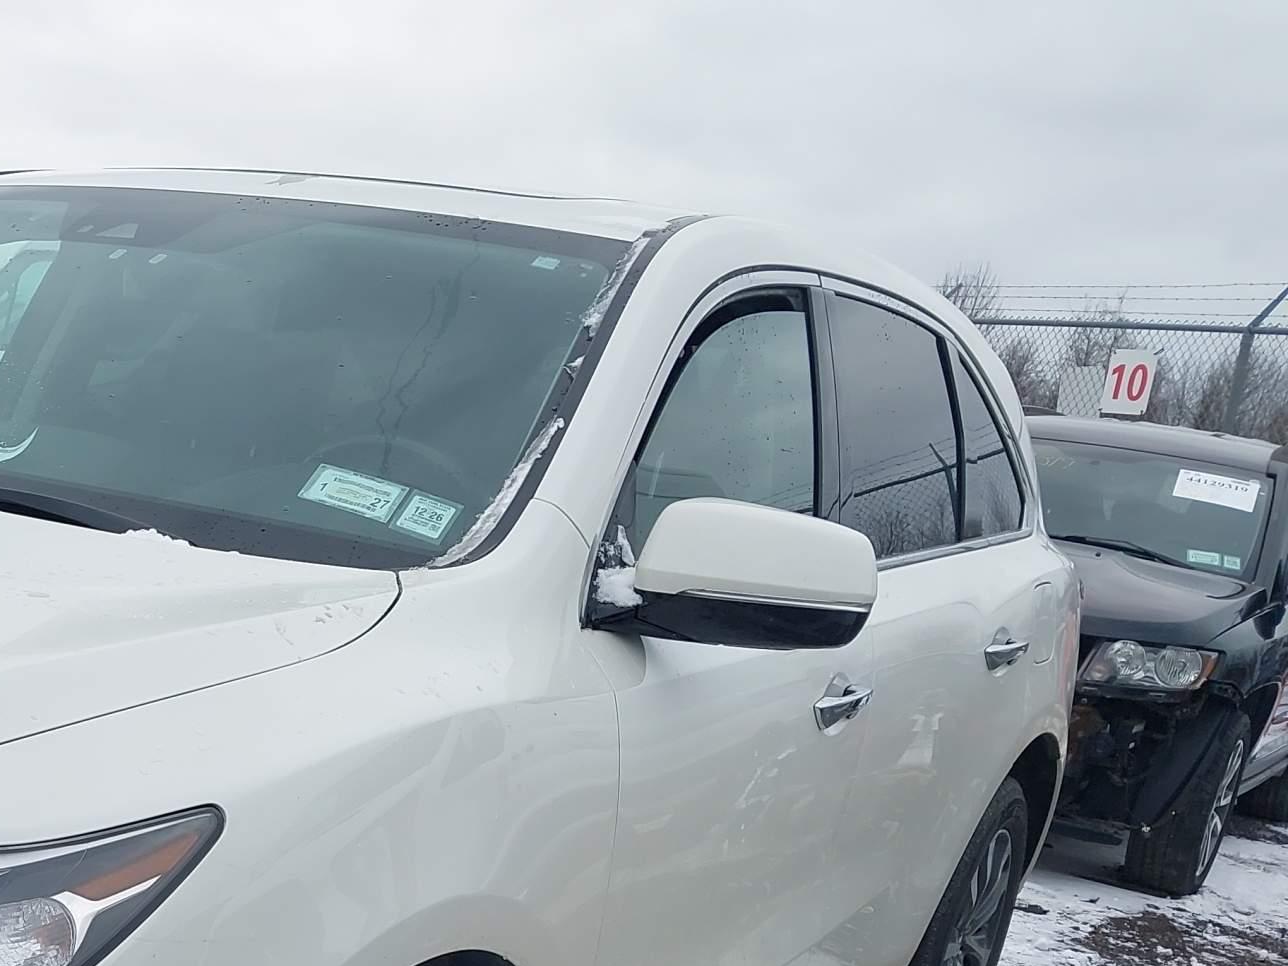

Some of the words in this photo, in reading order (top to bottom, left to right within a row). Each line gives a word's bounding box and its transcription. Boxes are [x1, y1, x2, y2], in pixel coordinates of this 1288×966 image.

[1110, 363, 1149, 402] 10
[369, 497, 391, 510] 27
[414, 506, 428, 517] 12
[428, 511, 445, 522] 26
